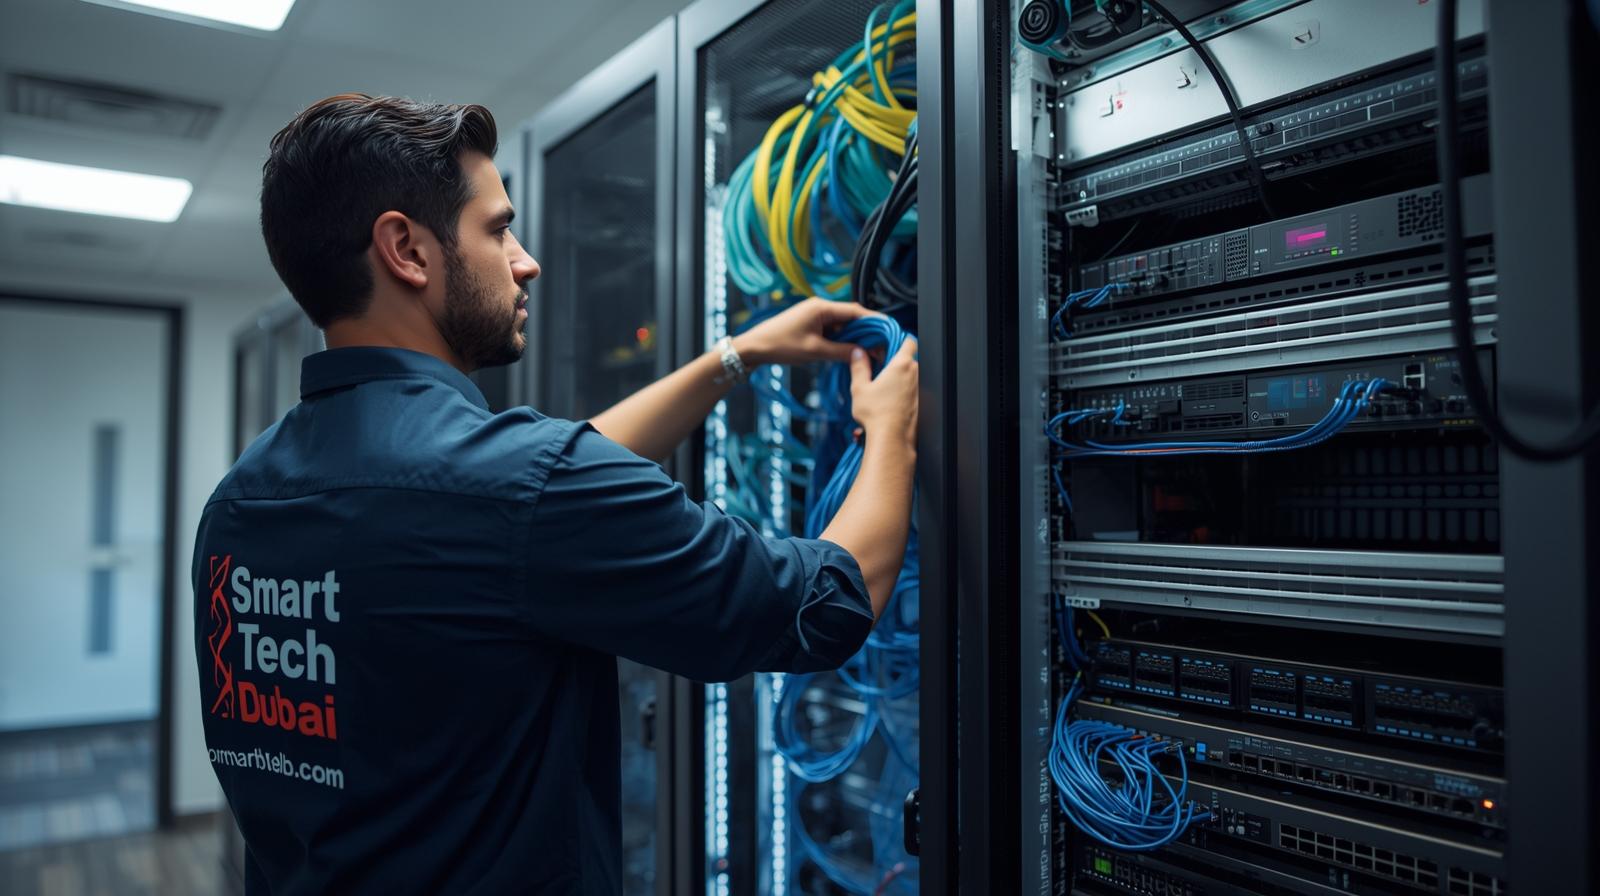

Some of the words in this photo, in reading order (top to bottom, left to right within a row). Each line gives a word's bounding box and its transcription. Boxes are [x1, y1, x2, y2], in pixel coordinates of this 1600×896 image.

[231, 566, 340, 622] Smart
[237, 622, 336, 684] Tech
[237, 681, 337, 740] Dubai
